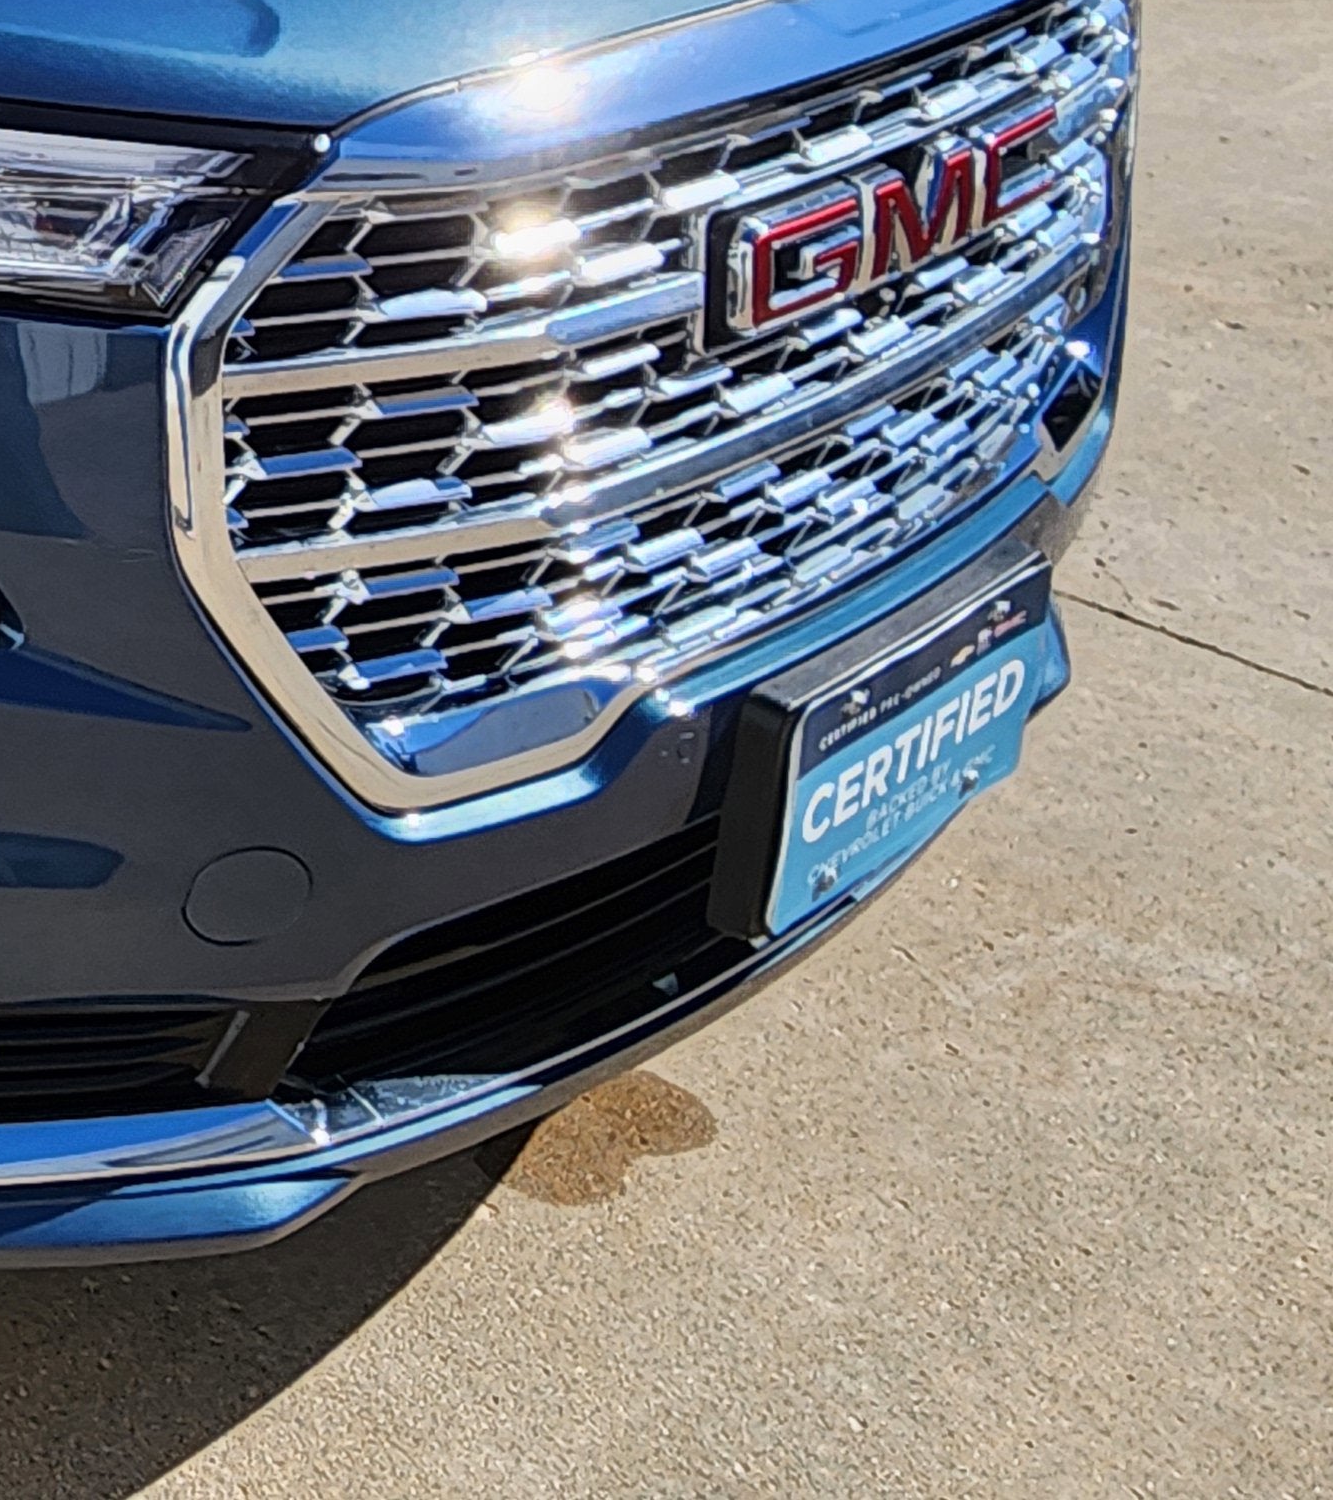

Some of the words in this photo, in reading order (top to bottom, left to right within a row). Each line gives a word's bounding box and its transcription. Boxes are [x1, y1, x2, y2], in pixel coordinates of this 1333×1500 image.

[727, 100, 1058, 330] GMC
[801, 658, 1026, 844] CERTIFIED
[818, 705, 877, 751] CERTIFIED
[865, 775, 928, 831] BACKED
